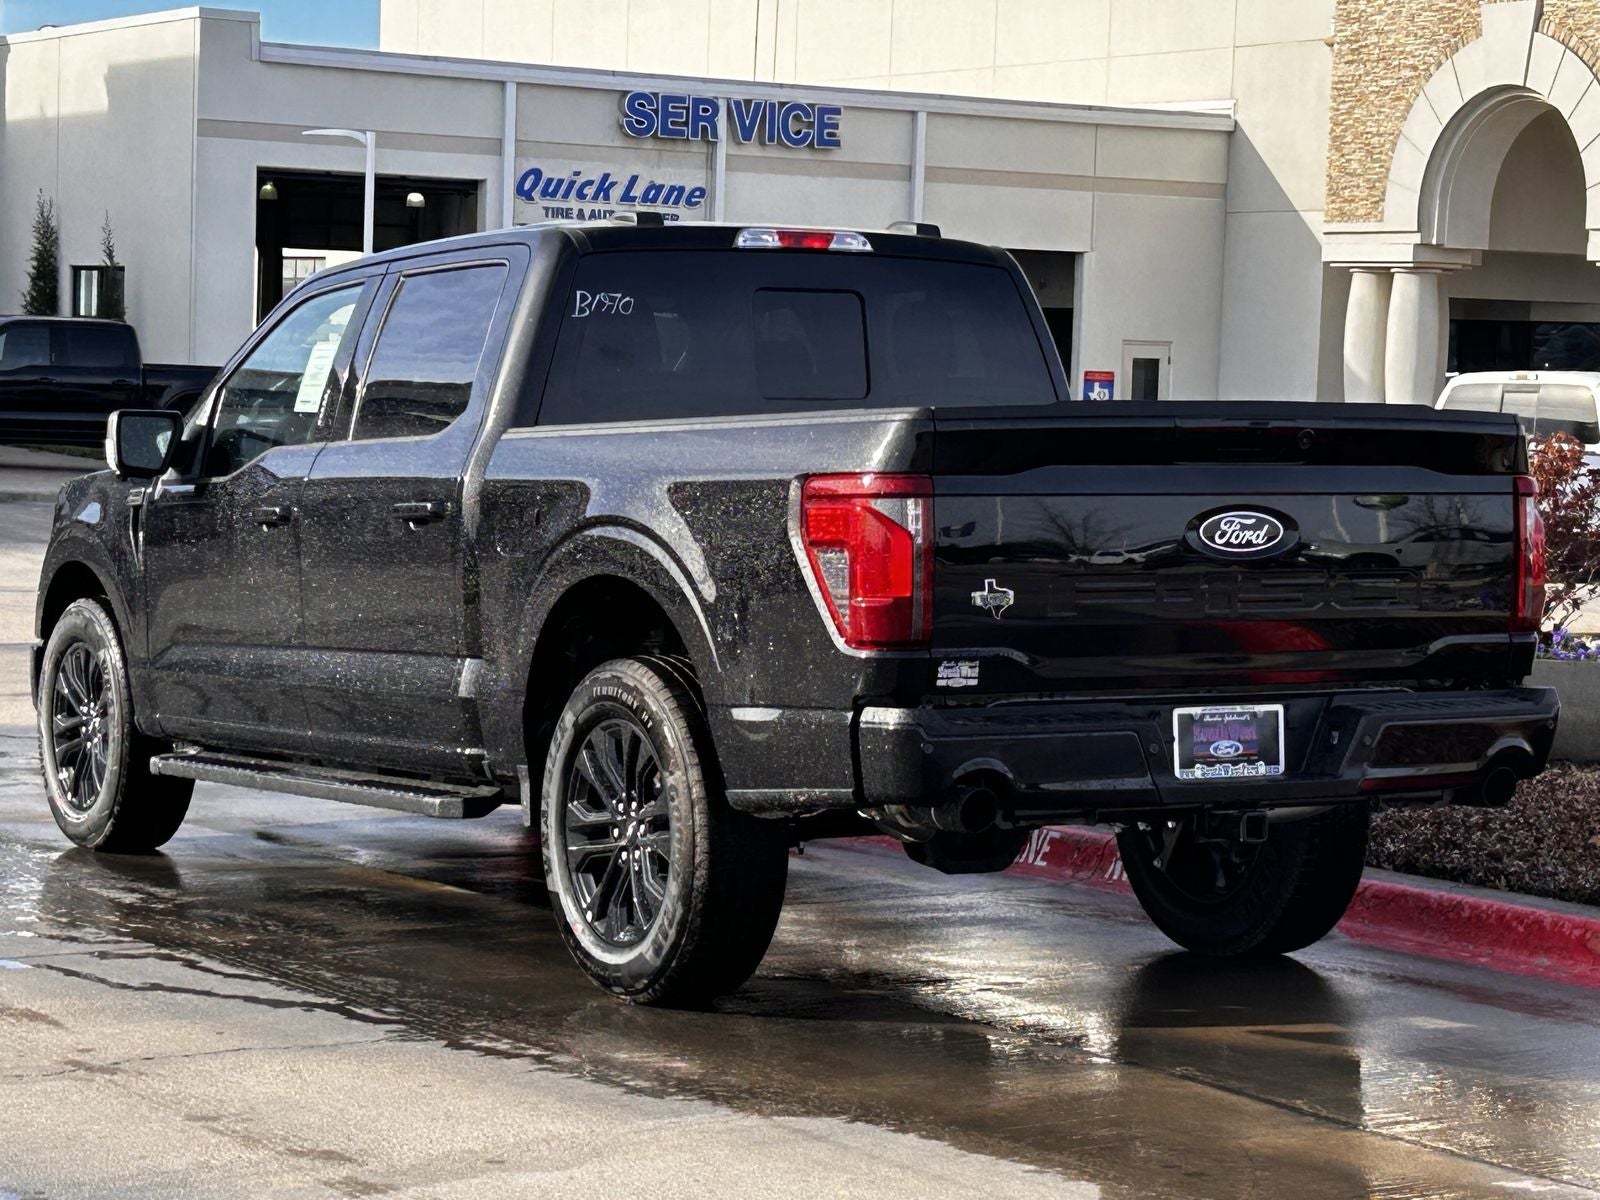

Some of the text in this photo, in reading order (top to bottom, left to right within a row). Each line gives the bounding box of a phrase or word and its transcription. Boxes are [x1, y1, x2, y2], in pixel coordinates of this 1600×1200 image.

[515, 167, 707, 209] Quick Lane
[542, 206, 574, 220] TIRE
[588, 208, 616, 221] AUT
[1214, 516, 1269, 545] Ford
